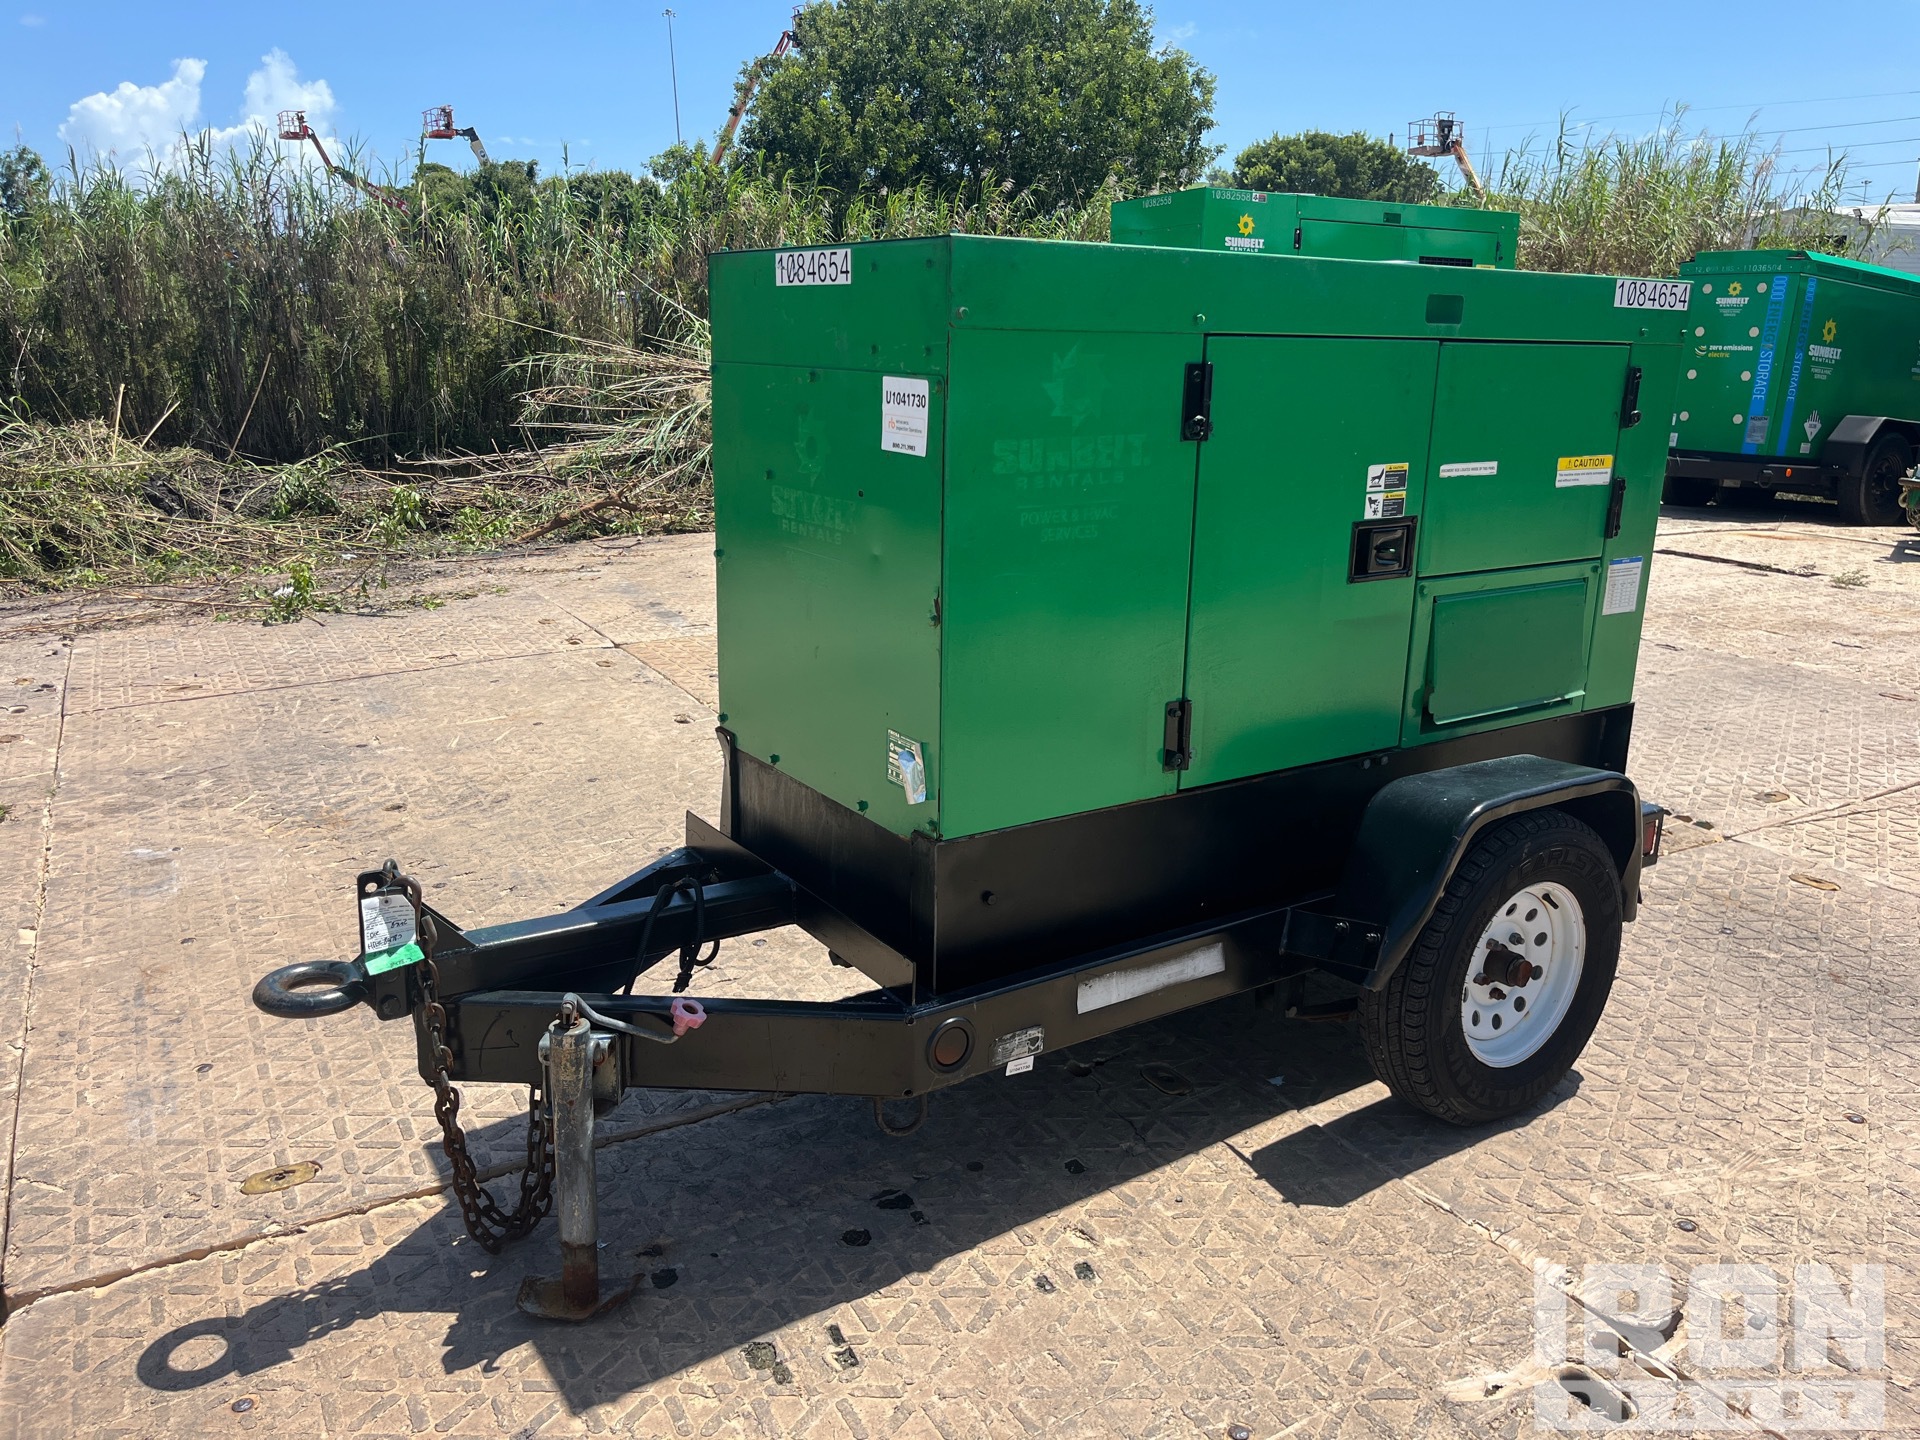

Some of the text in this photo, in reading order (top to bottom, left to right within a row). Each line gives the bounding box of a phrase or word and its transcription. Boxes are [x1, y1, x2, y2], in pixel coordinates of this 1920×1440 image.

[1142, 195, 1172, 209] 10382558
[1211, 189, 1251, 202] 10382558
[1224, 236, 1265, 249] SUNBELT
[776, 250, 851, 286] 1084654
[1616, 281, 1689, 310] 1084654
[1715, 296, 1751, 305] SUNBELT
[1723, 344, 1754, 352] emissions
[1808, 344, 1843, 360] SUNBELT
[1752, 350, 1773, 401] STORAGE
[1786, 351, 1803, 402] STORAGE
[885, 390, 927, 409] U1041730
[1573, 458, 1605, 468] CAUTION
